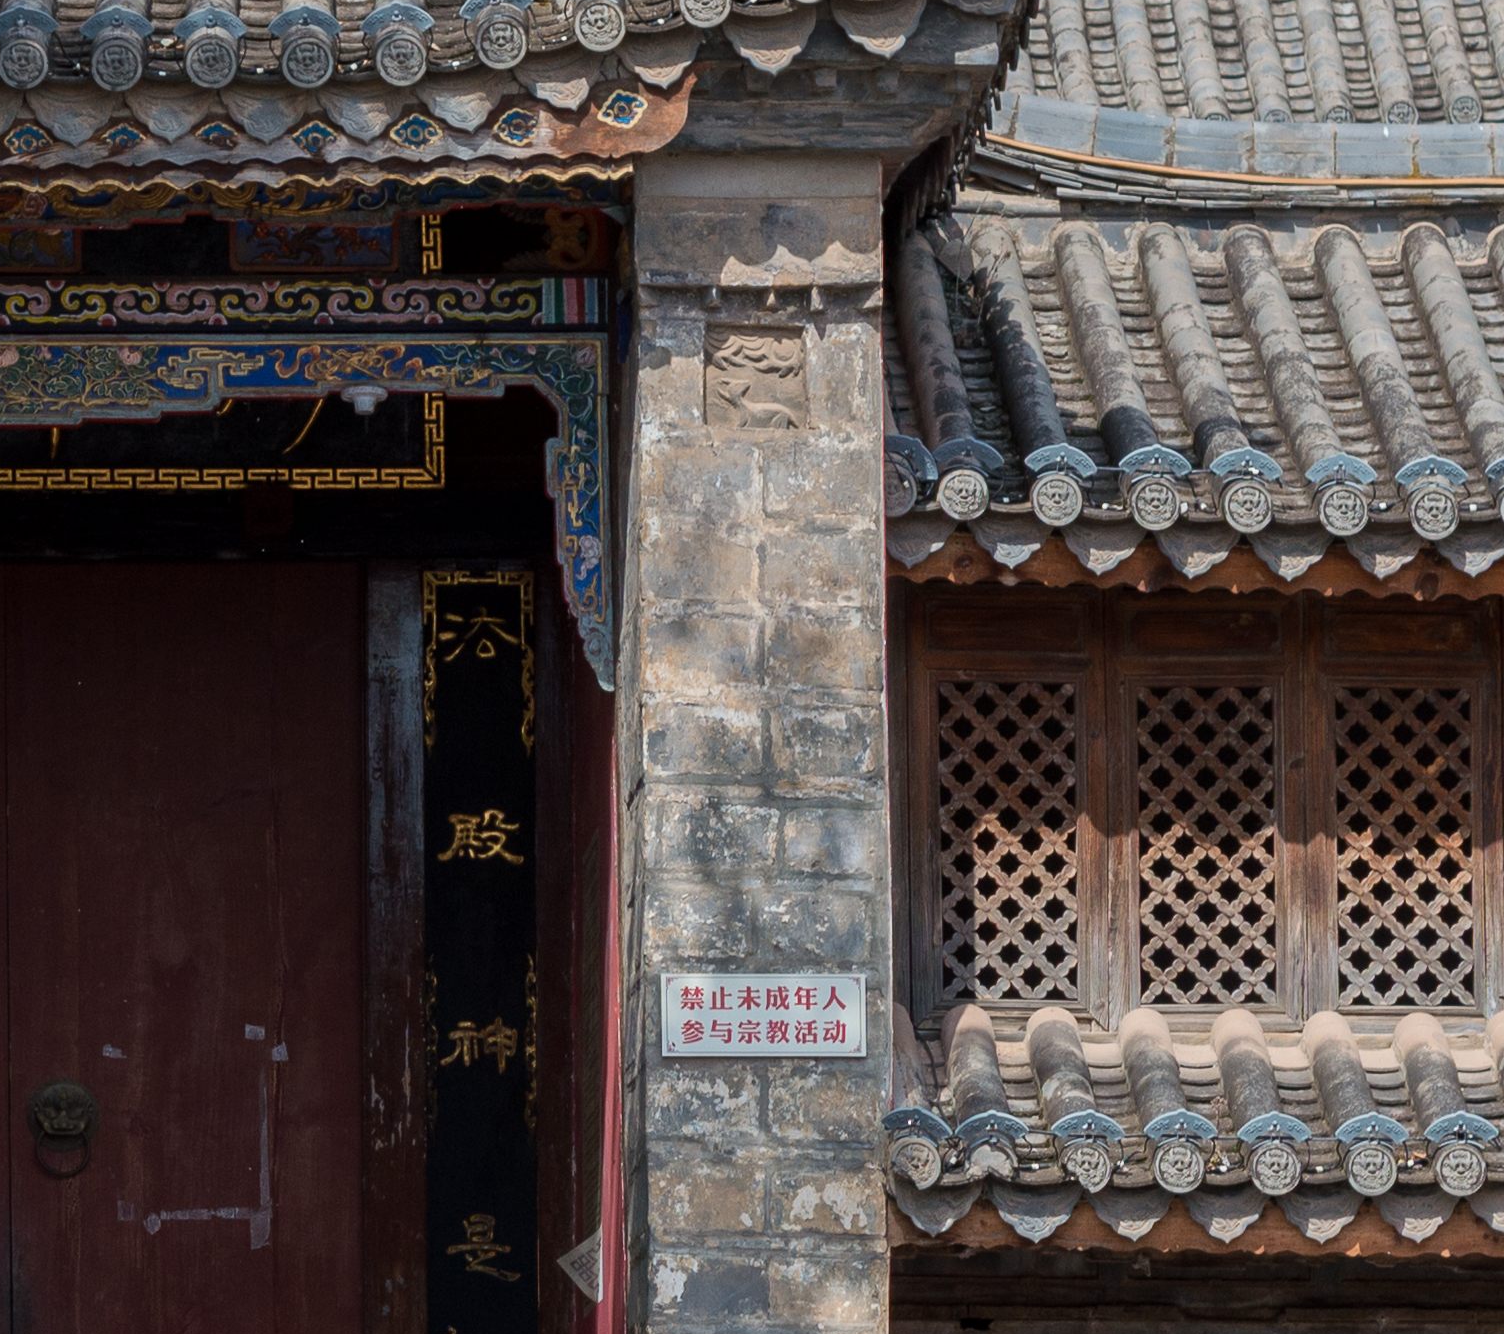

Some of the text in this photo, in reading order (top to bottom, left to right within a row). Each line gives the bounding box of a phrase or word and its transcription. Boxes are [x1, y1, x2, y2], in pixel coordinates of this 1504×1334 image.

[679, 986, 847, 1011] 禁止未成年人
[680, 1019, 847, 1044] 参与宗教活动
